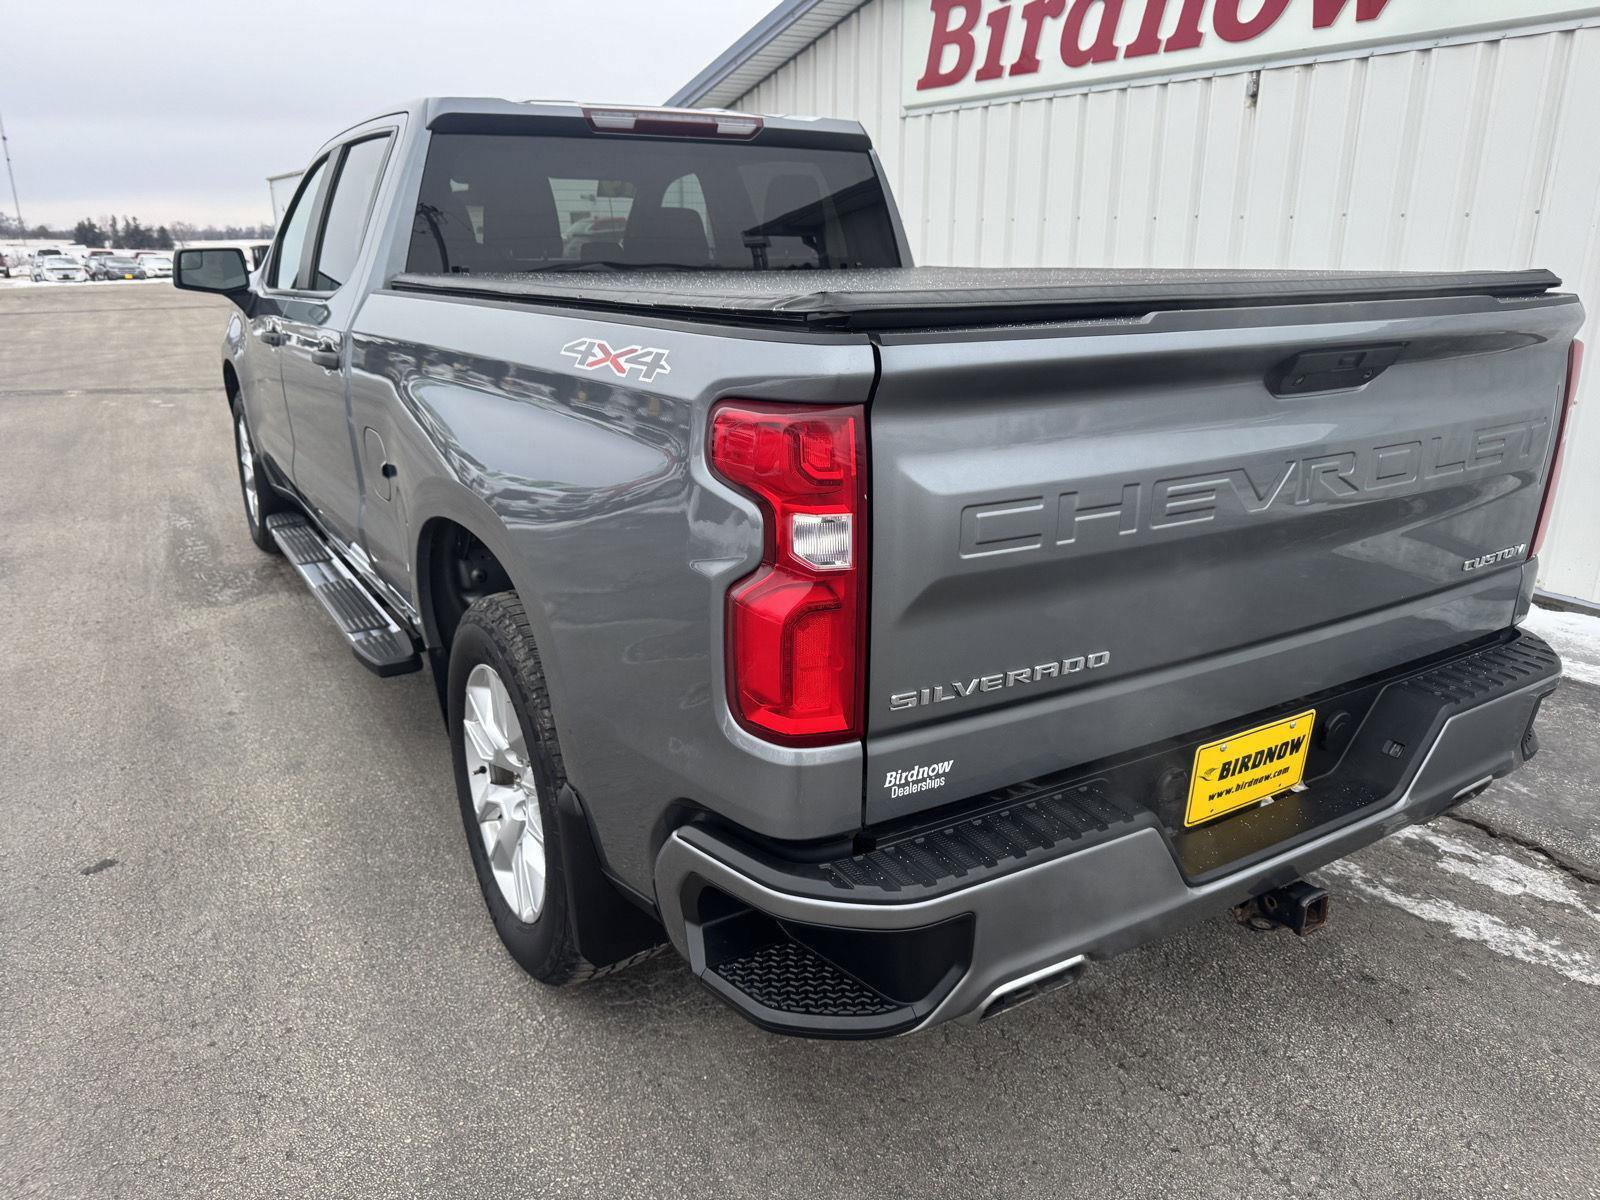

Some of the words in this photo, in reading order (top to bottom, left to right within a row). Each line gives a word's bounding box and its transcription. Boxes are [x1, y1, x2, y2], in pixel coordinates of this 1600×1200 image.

[960, 416, 1547, 560] CHEVROLET
[1462, 543, 1527, 571] CUSTOM
[889, 650, 1111, 711] SILVERADO
[883, 759, 954, 788] Birdnow
[1218, 734, 1306, 781] BIRDNOW
[891, 776, 946, 798] Dealerships
[1208, 766, 1290, 801] www.birdnow.com
